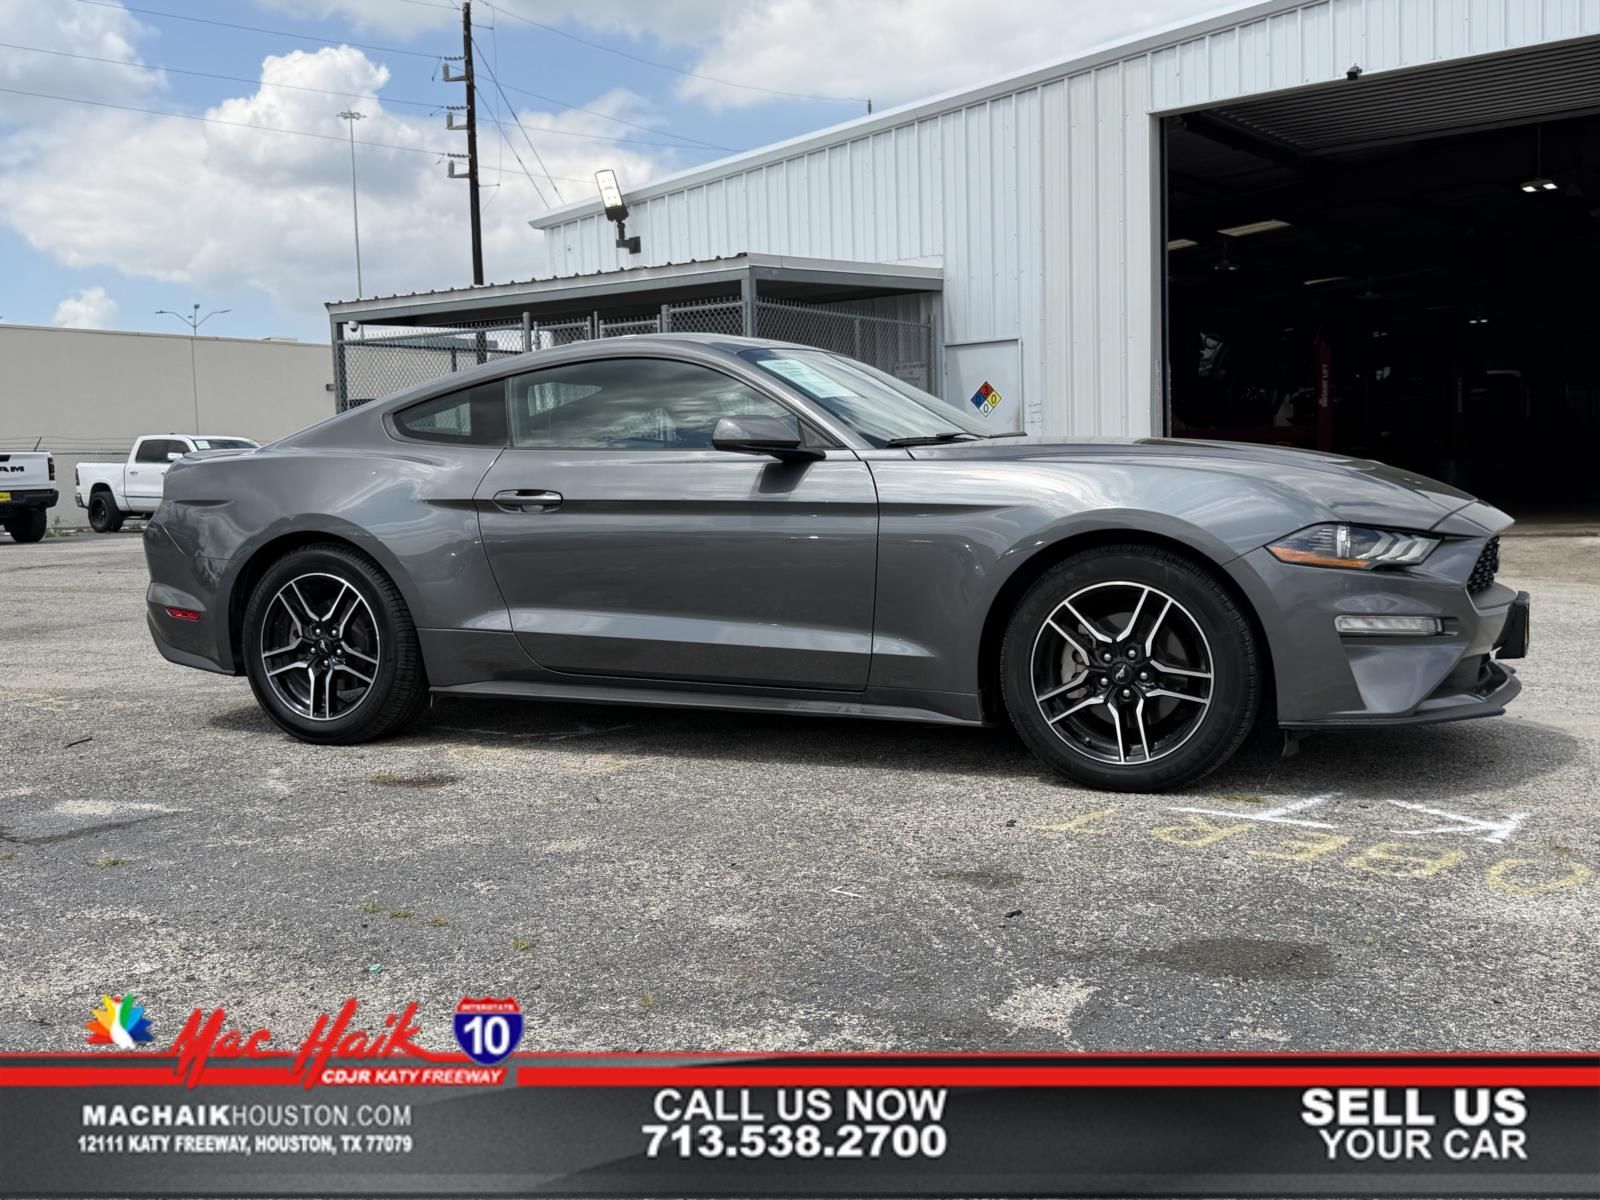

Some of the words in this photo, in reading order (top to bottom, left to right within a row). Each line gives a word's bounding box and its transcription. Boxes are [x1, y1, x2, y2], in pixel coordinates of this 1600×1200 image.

[983, 385, 989, 396] 3
[990, 394, 997, 405] 0
[983, 403, 988, 413] 0
